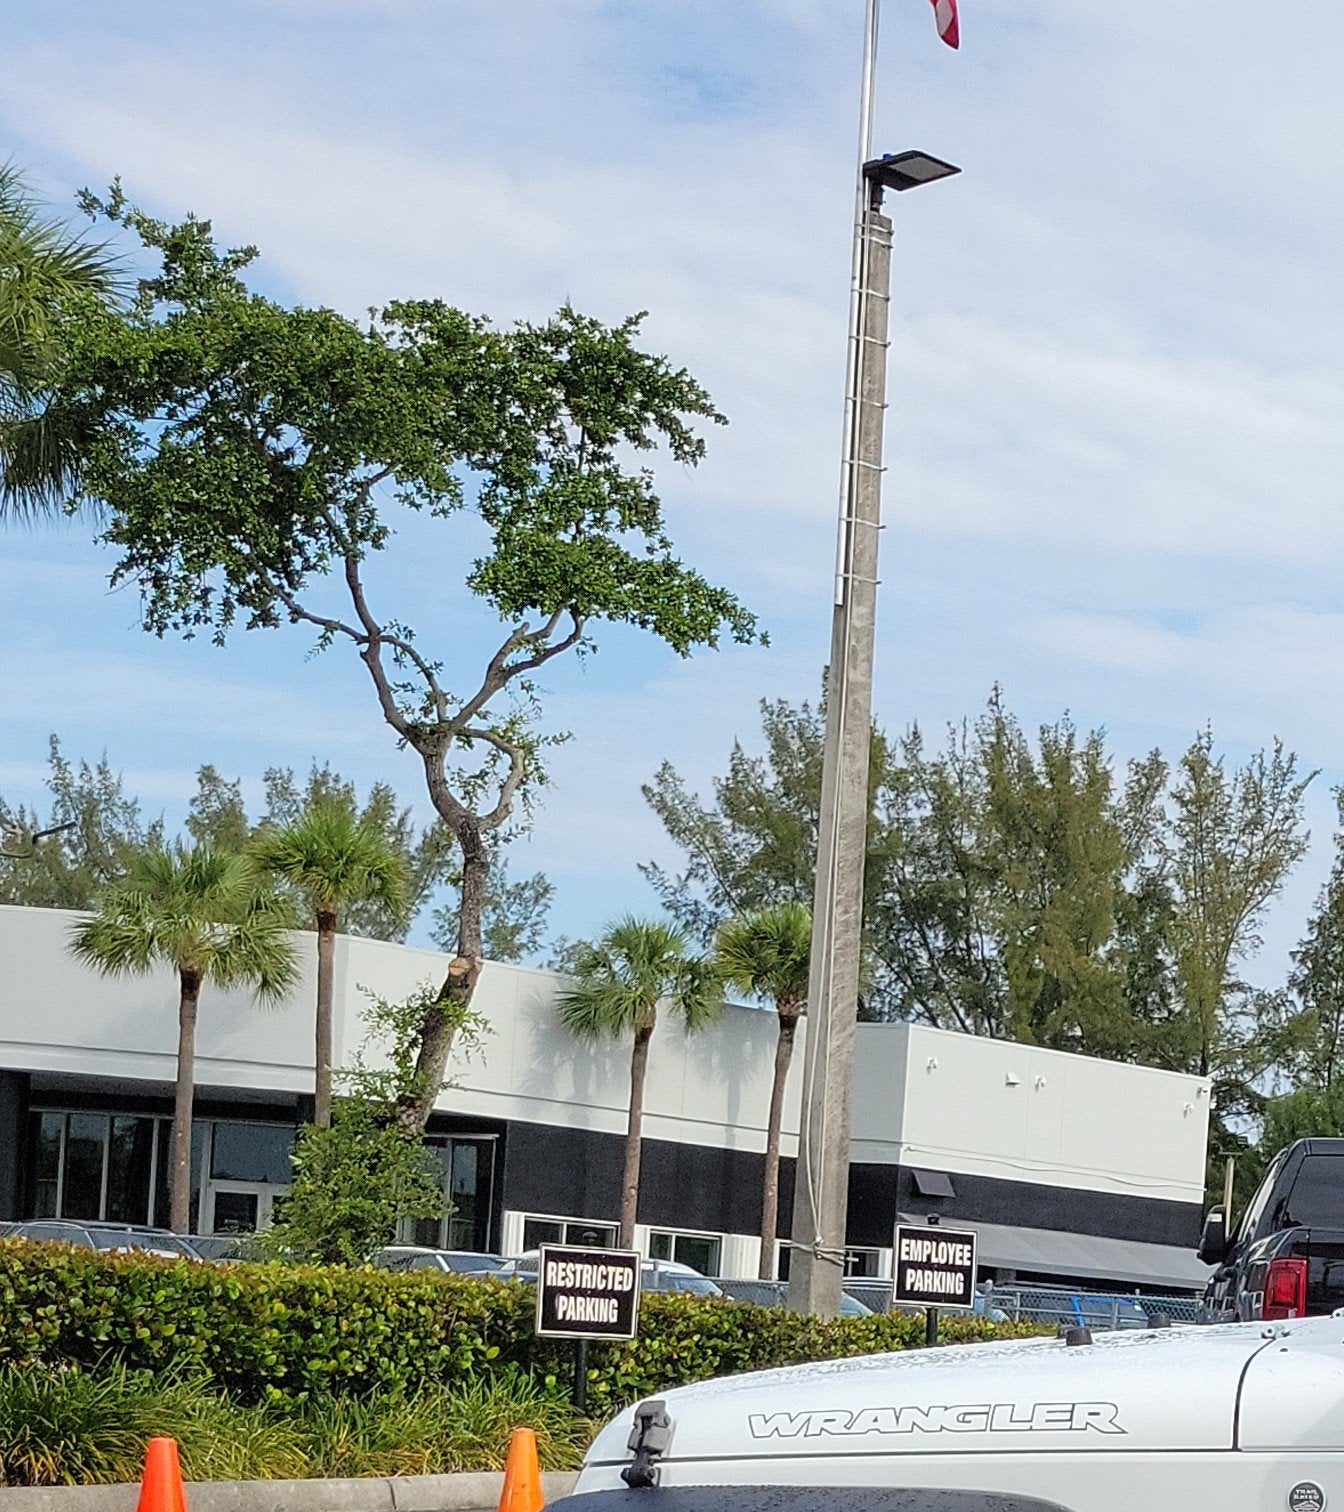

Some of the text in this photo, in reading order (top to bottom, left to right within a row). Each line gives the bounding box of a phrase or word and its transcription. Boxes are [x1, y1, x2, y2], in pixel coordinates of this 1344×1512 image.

[901, 1238, 972, 1266] EMPLOYEE
[546, 1261, 634, 1292] RESTRICTED
[905, 1268, 965, 1295] PARKING
[557, 1295, 619, 1323] PARKING
[748, 1402, 1128, 1438] WRANGLER
